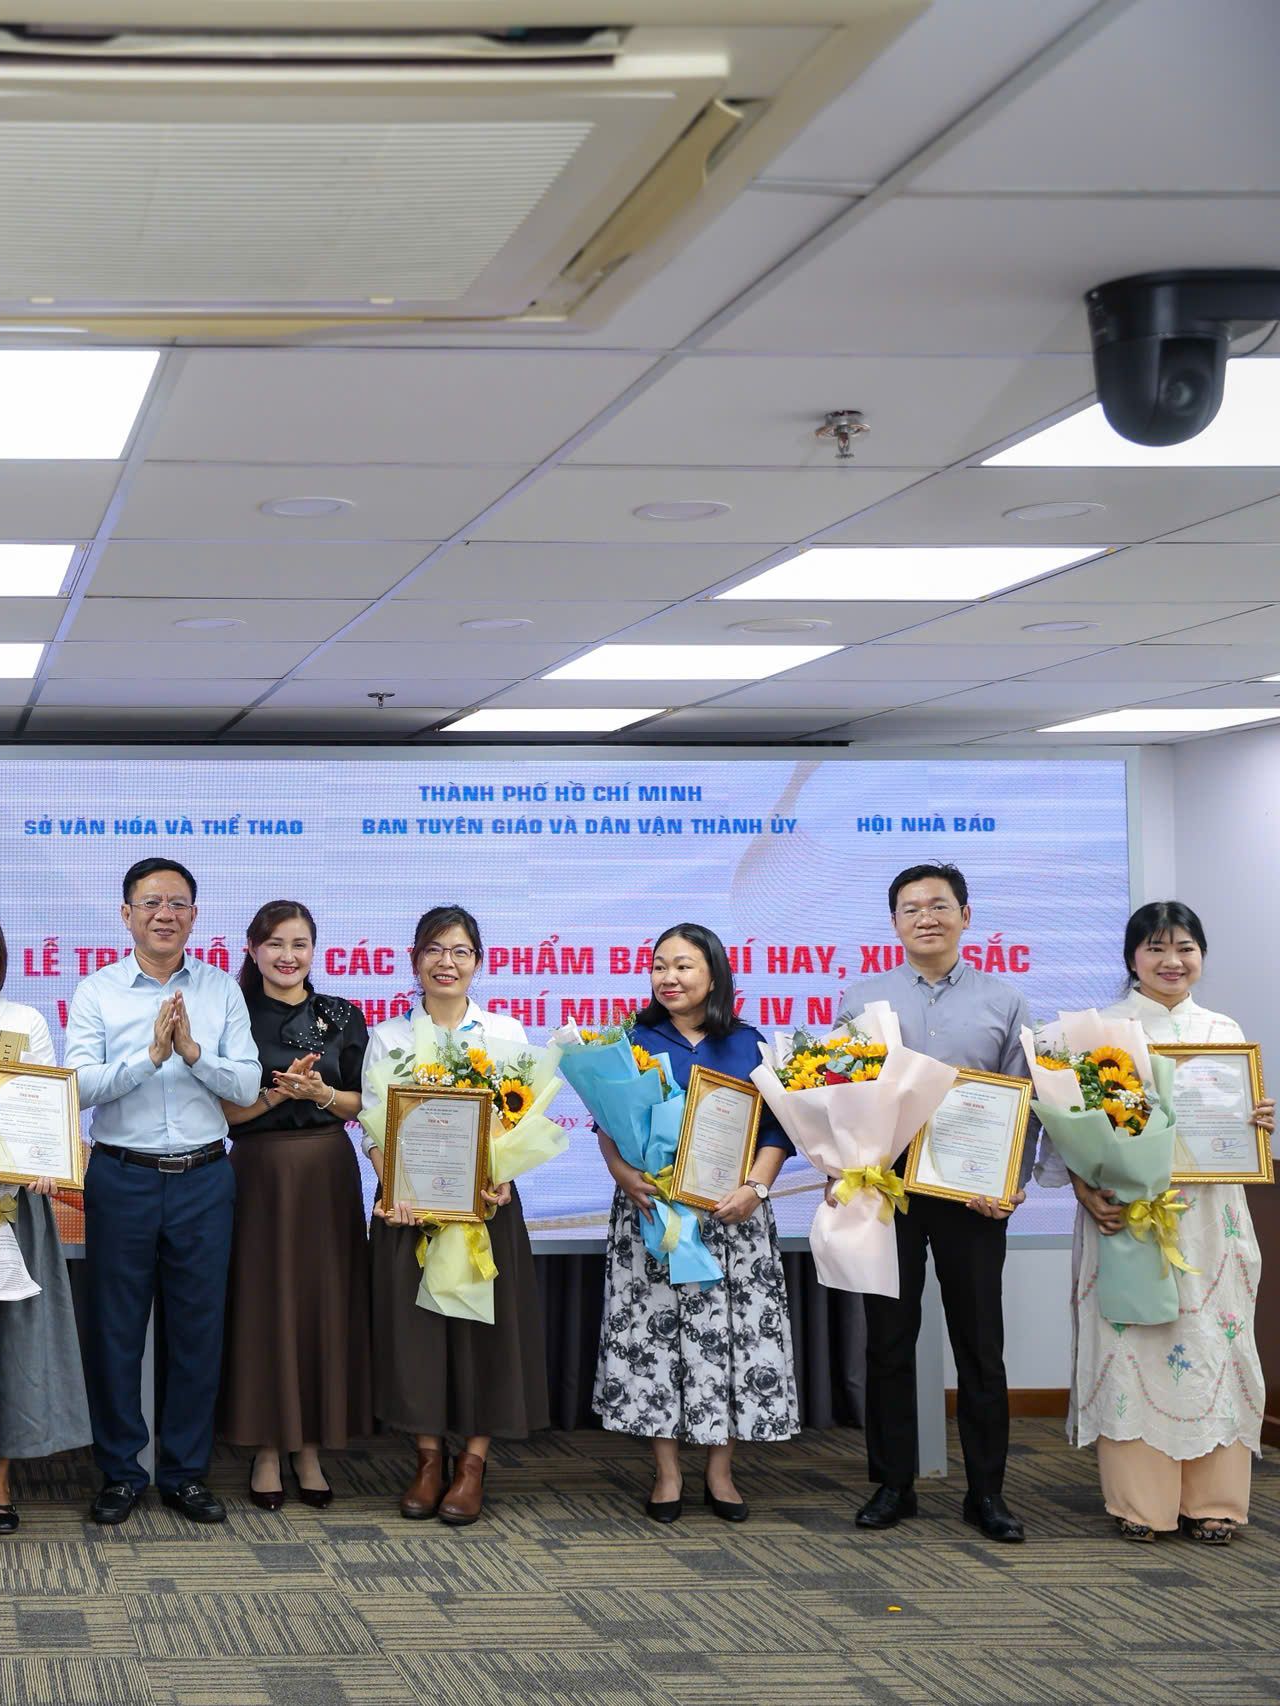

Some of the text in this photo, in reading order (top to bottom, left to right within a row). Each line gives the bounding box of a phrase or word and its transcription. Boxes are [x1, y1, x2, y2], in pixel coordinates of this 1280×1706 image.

[419, 780, 702, 801] THÀNH PHỐ HỒ CHÍ MINH
[24, 813, 304, 835] SỞ VĂN HÓA VÀ THỂ THAO
[362, 813, 798, 837] BAN TUYÊN GIÁO VÀ DÂN VẬN THÀNH ỦY
[856, 813, 996, 835] HỘI NHÀ BÁO
[23, 936, 61, 977] LỄ
[325, 938, 395, 976] CÁC
[487, 934, 595, 975] PHẨM
[609, 938, 654, 975] BÁ
[767, 945, 847, 980] HAY,
[860, 945, 906, 974] XU
[961, 932, 1031, 973] SẮC
[760, 997, 794, 1026] IV
